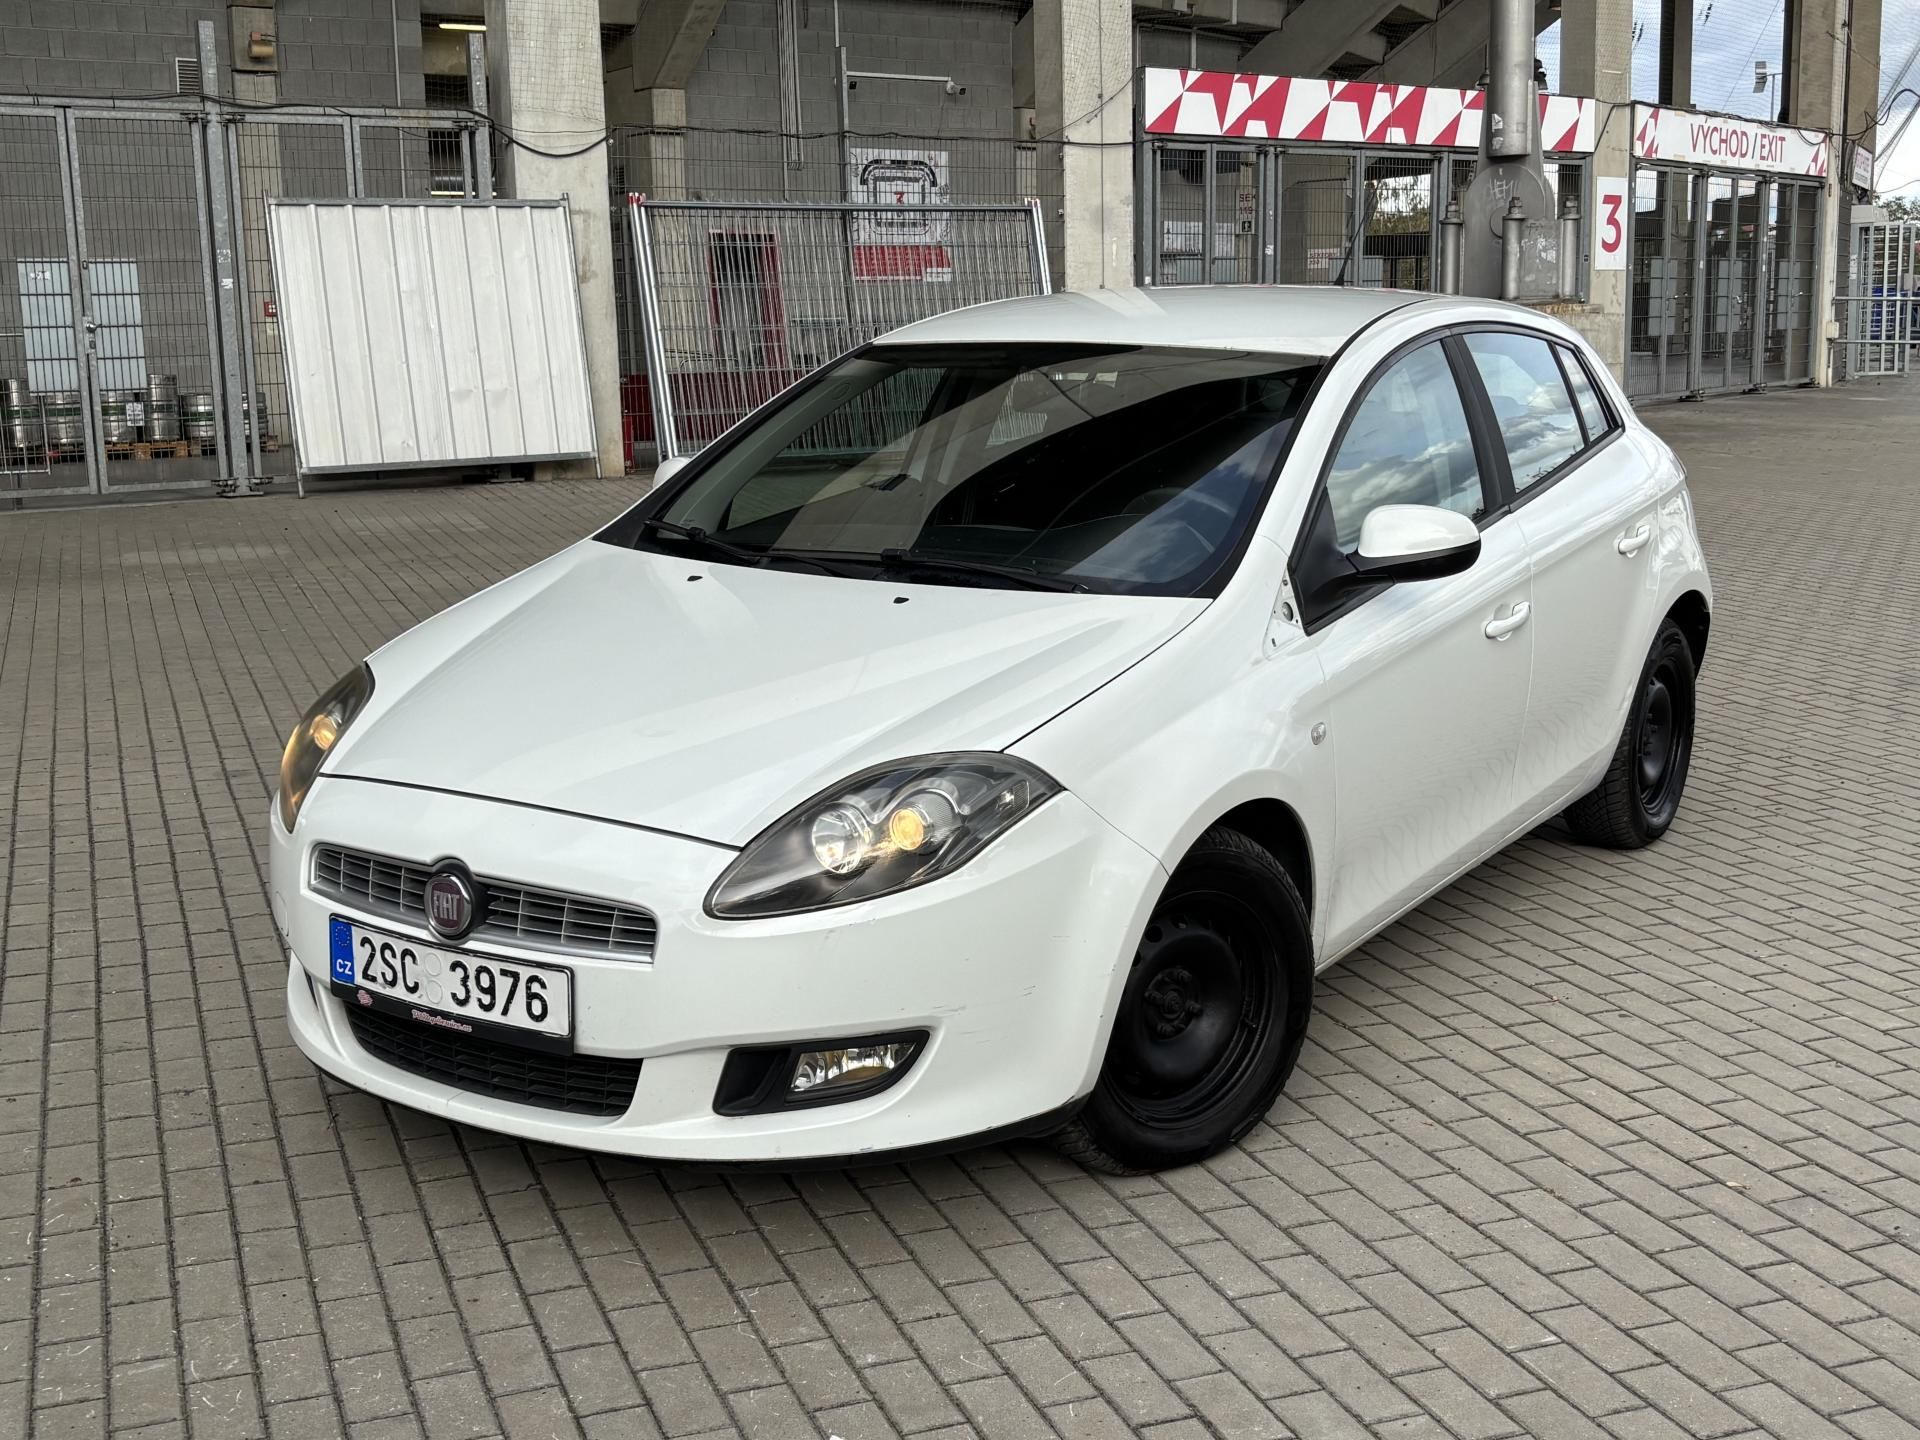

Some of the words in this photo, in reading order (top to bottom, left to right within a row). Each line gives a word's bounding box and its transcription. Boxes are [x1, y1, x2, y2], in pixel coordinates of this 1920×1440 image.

[1690, 117, 1750, 158] VÝCHOD
[1751, 133, 1758, 160] /
[1760, 133, 1787, 163] EXIT
[1601, 194, 1623, 253] 3
[433, 890, 460, 920] FIAT
[336, 958, 353, 976] CZ
[360, 936, 420, 995] 2SC
[449, 960, 549, 1023] 3976
